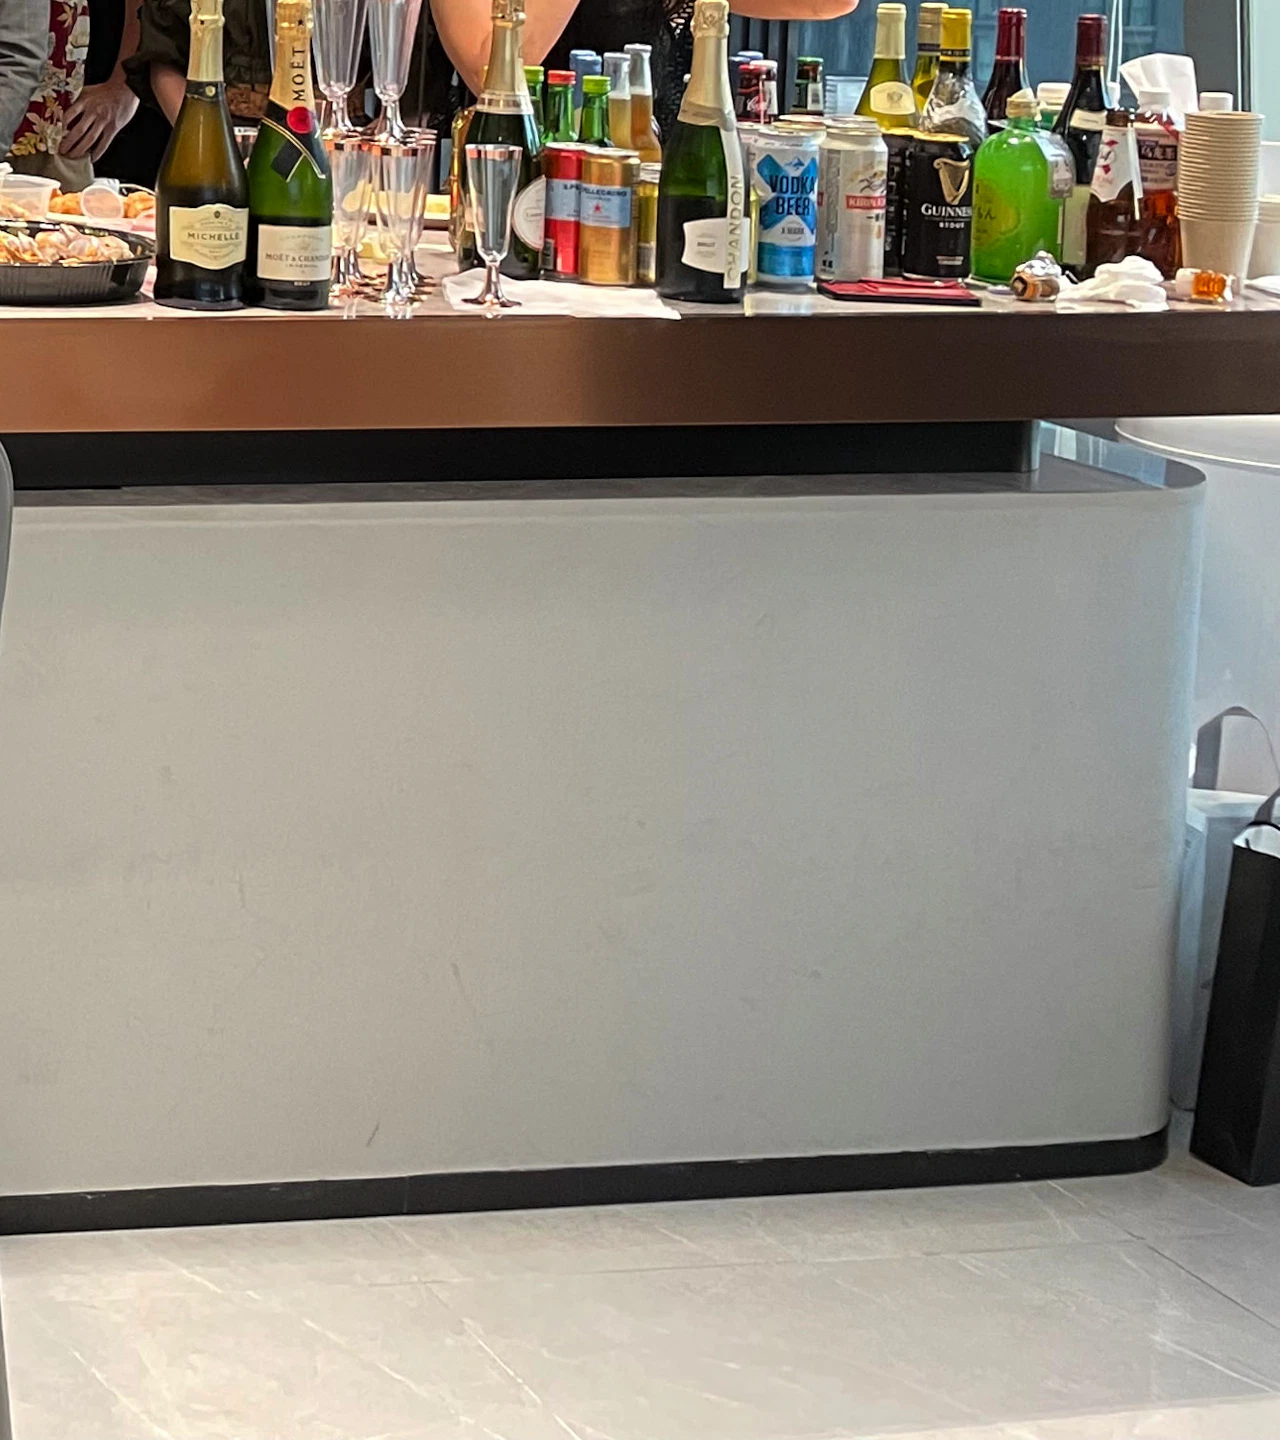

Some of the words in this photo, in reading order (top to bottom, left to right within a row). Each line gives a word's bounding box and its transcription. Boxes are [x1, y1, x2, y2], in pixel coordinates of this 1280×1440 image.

[769, 175, 816, 195] VODKA
[775, 196, 810, 215] BEER
[187, 232, 240, 241] MICHELLE
[726, 175, 743, 281] CHANDON
